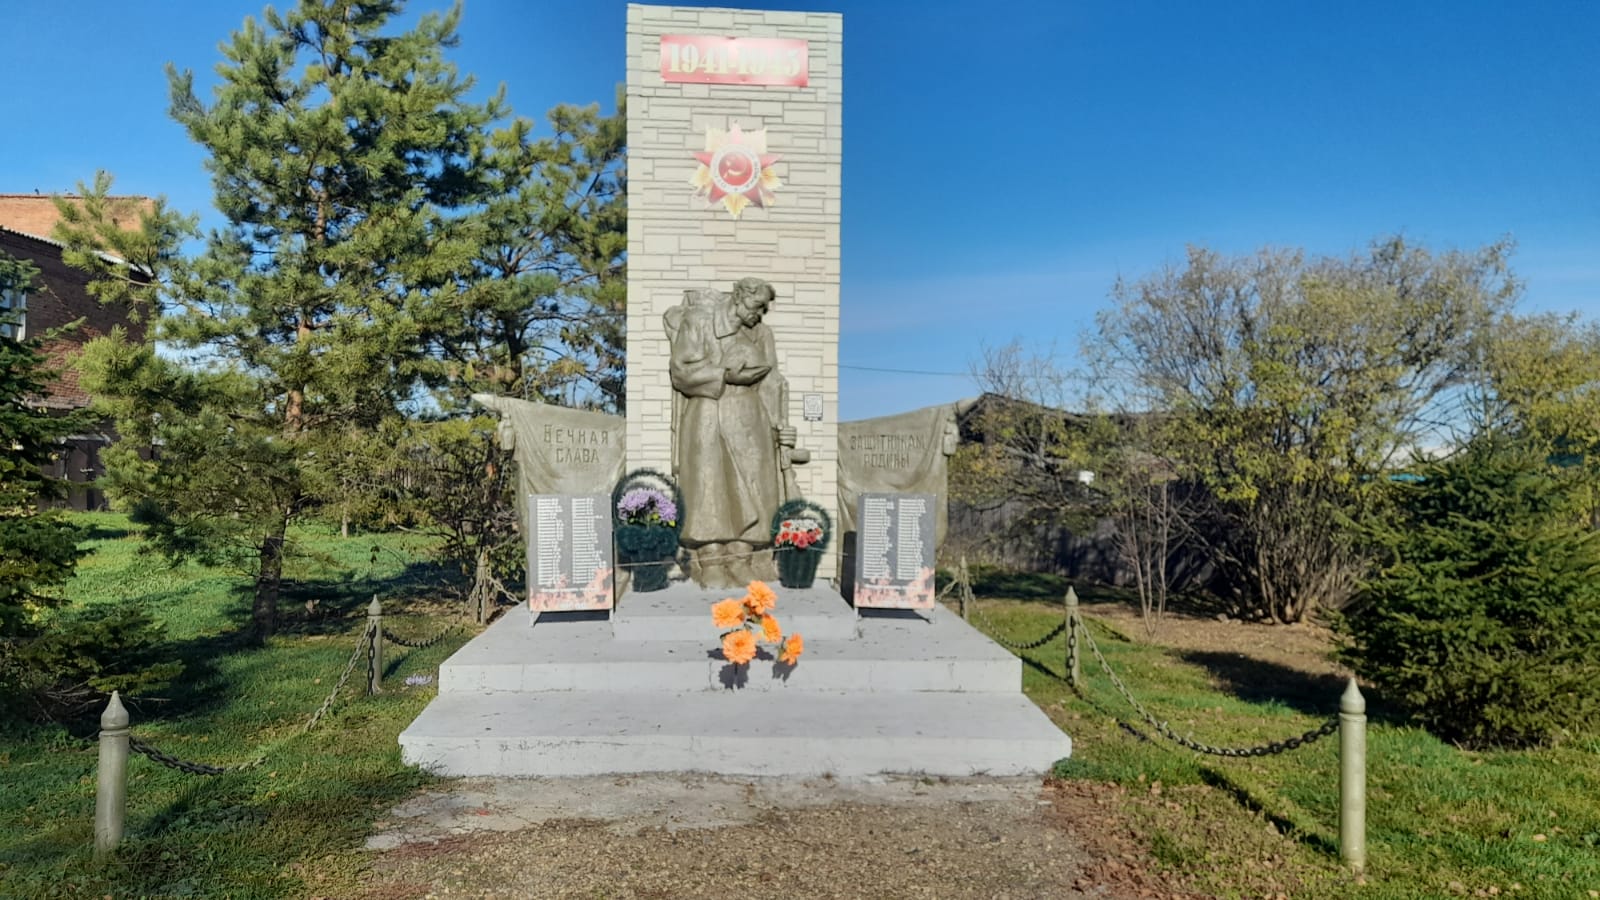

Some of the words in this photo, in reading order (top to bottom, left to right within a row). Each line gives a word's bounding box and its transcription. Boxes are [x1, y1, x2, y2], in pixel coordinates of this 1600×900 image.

[668, 43, 801, 77] 1941-1945
[543, 424, 609, 445] ВЕЧНАЯ
[555, 448, 600, 463] СЛАВА
[863, 453, 910, 468] РОДИНЫ
